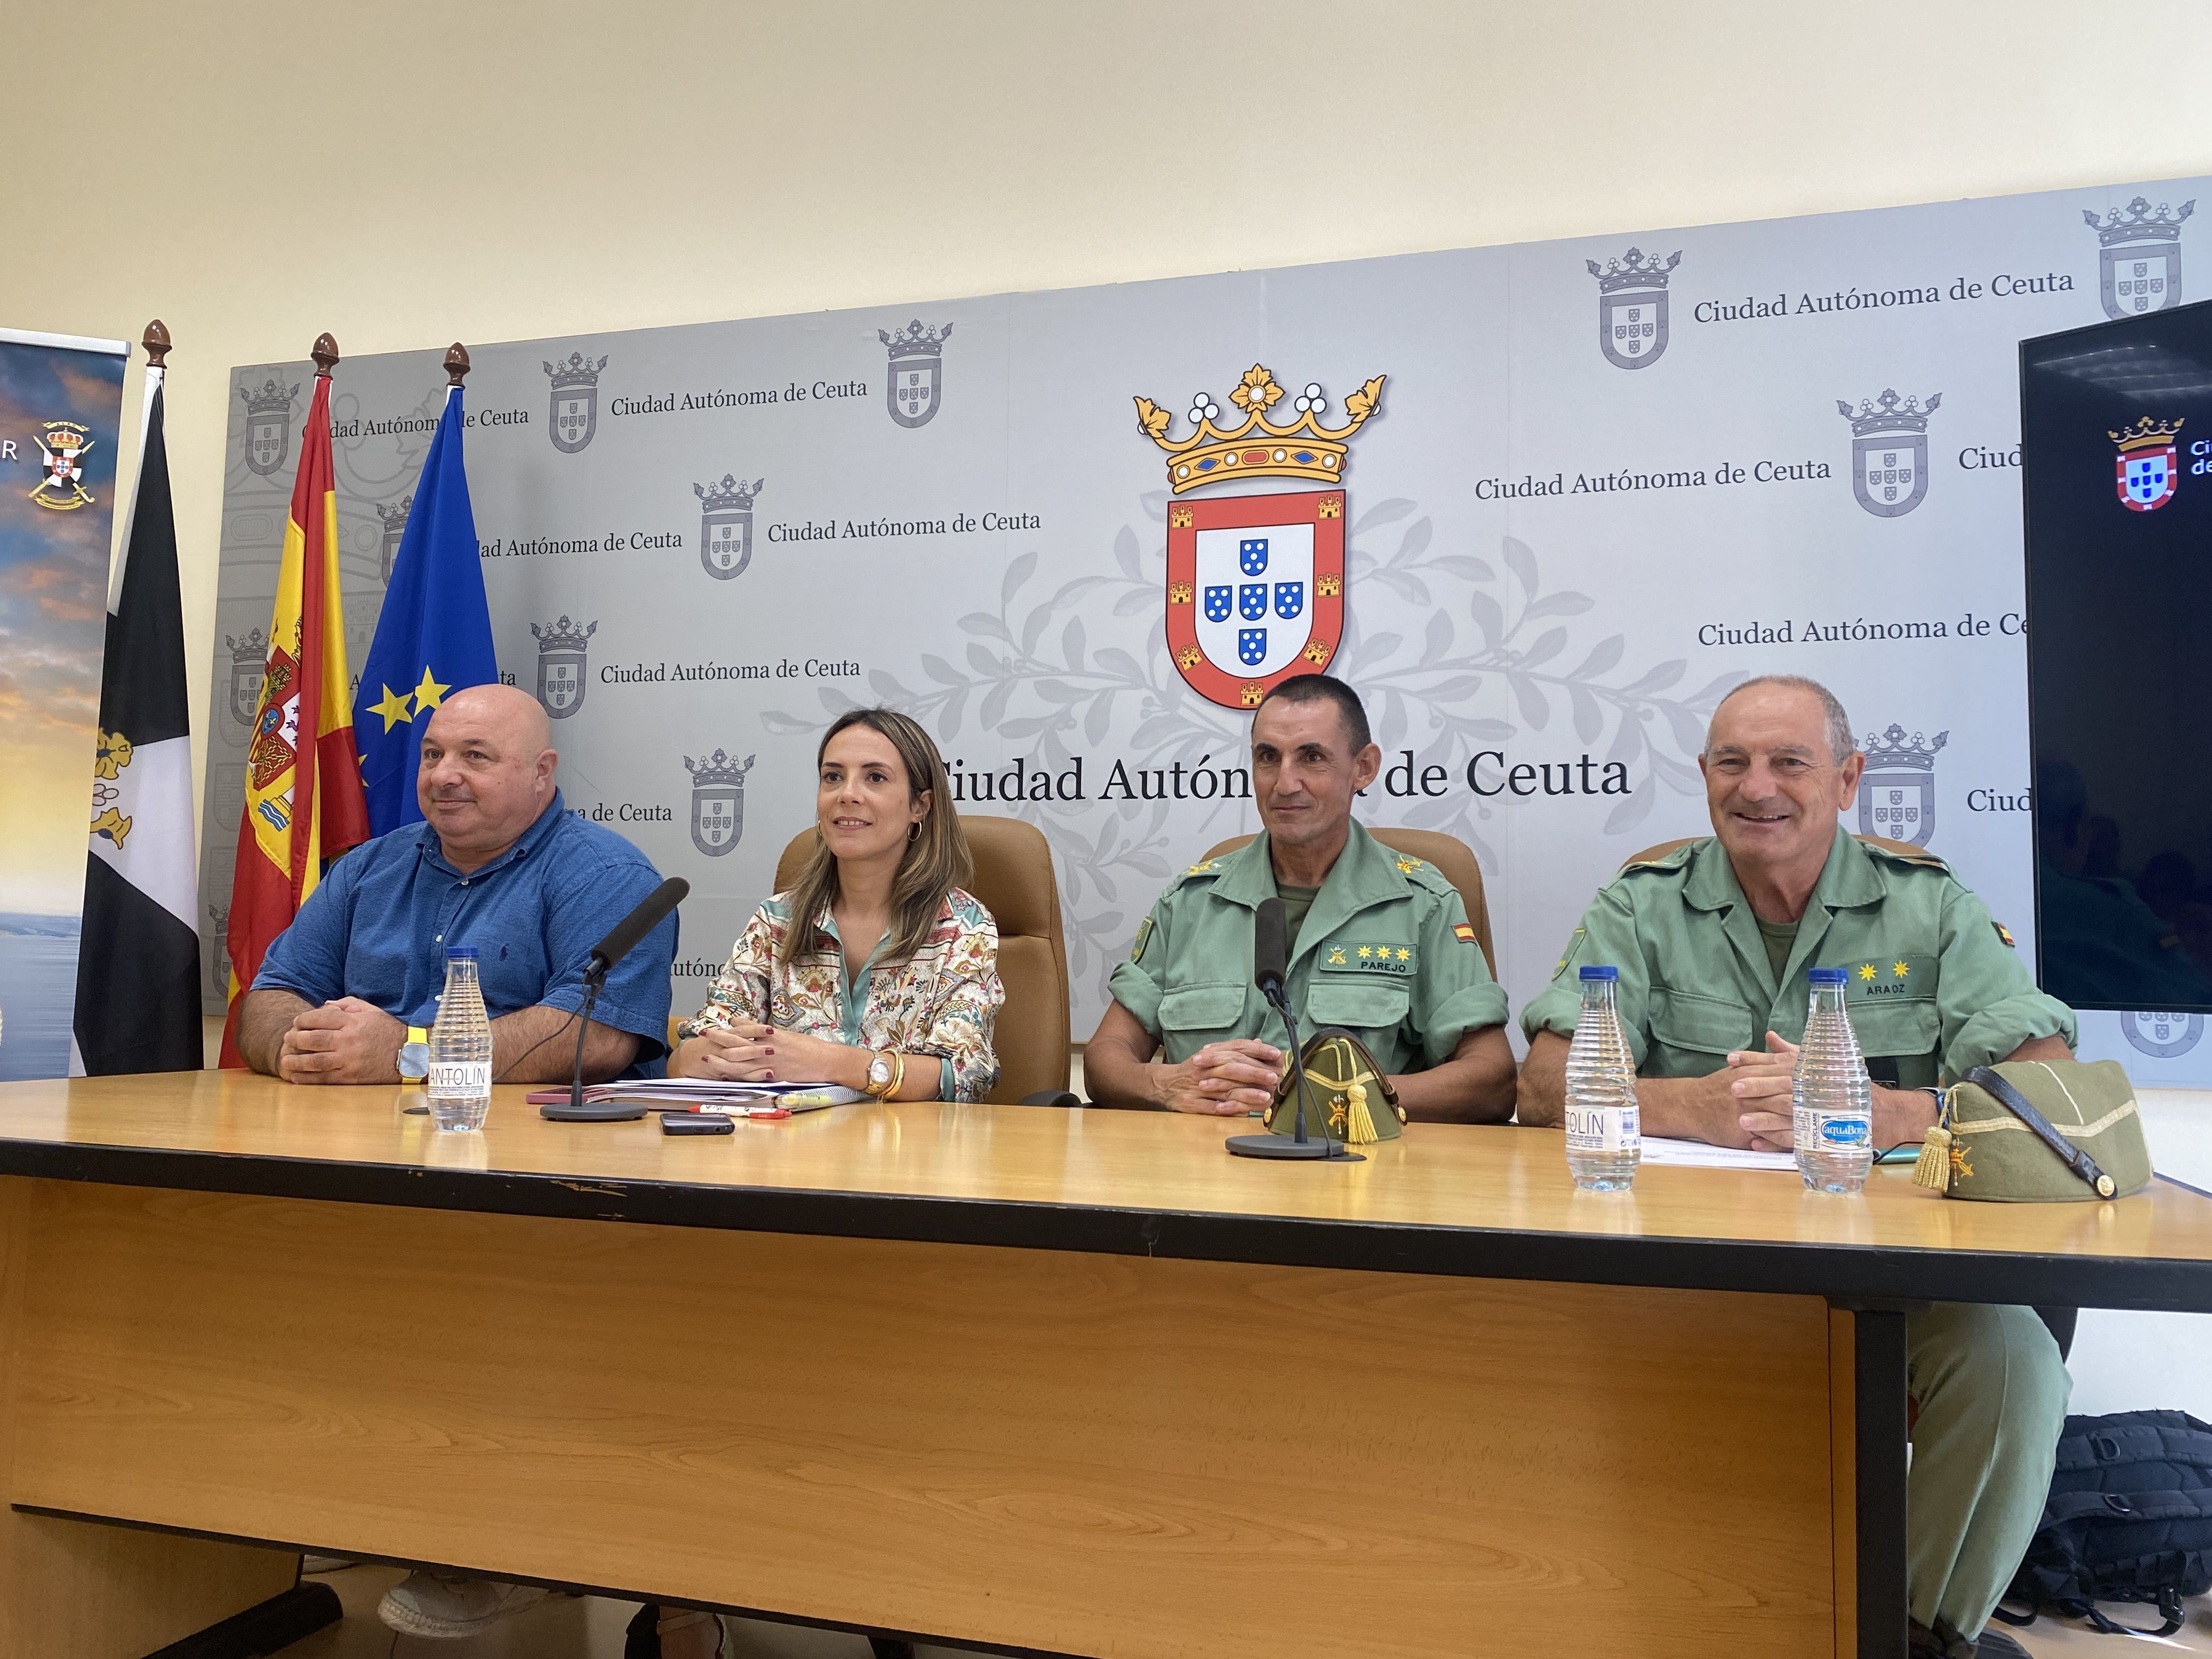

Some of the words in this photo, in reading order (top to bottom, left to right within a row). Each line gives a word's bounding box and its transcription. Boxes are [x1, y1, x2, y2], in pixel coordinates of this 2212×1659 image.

[1695, 294, 1788, 323] Ciudad
[1795, 287, 1941, 315] Autónoma
[1950, 278, 1982, 300] de
[1992, 273, 2074, 296] Ceuta
[612, 393, 675, 416] Ciudad
[680, 388, 778, 410] Autónoma
[784, 383, 806, 402] de
[812, 381, 867, 399] Ceuta
[480, 409, 529, 426] Ceuta
[2191, 459, 2212, 475] de
[1476, 474, 1564, 499] Ciudad
[1571, 469, 1707, 493] Autónoma
[1716, 462, 1746, 484] de
[1754, 461, 1831, 482] Ceuta
[769, 520, 836, 542] Ciudad
[841, 517, 946, 538] Autónoma
[952, 513, 976, 532] de
[983, 513, 1041, 531] Ceuta
[506, 537, 598, 556] Autónoma
[604, 533, 624, 551] de
[630, 532, 682, 549] Ceuta
[1699, 621, 1794, 646] Ciudad
[1801, 618, 1948, 642] Autónoma
[1957, 613, 1990, 636] de
[601, 663, 665, 684] Ciudad
[670, 661, 770, 681] Autónoma
[776, 658, 798, 678] de
[805, 659, 860, 678] Ceuta
[944, 757, 1086, 802] iudad
[1385, 750, 1448, 797] de
[1467, 751, 1633, 797] Ceuta
[592, 803, 613, 821] de
[619, 804, 672, 821] Ceuta
[1361, 962, 1406, 973] PAREJO
[1867, 984, 1905, 995] ARAOZ
[430, 1066, 485, 1085] ANTOLÍN
[1824, 1125, 1867, 1136] aquaBona
